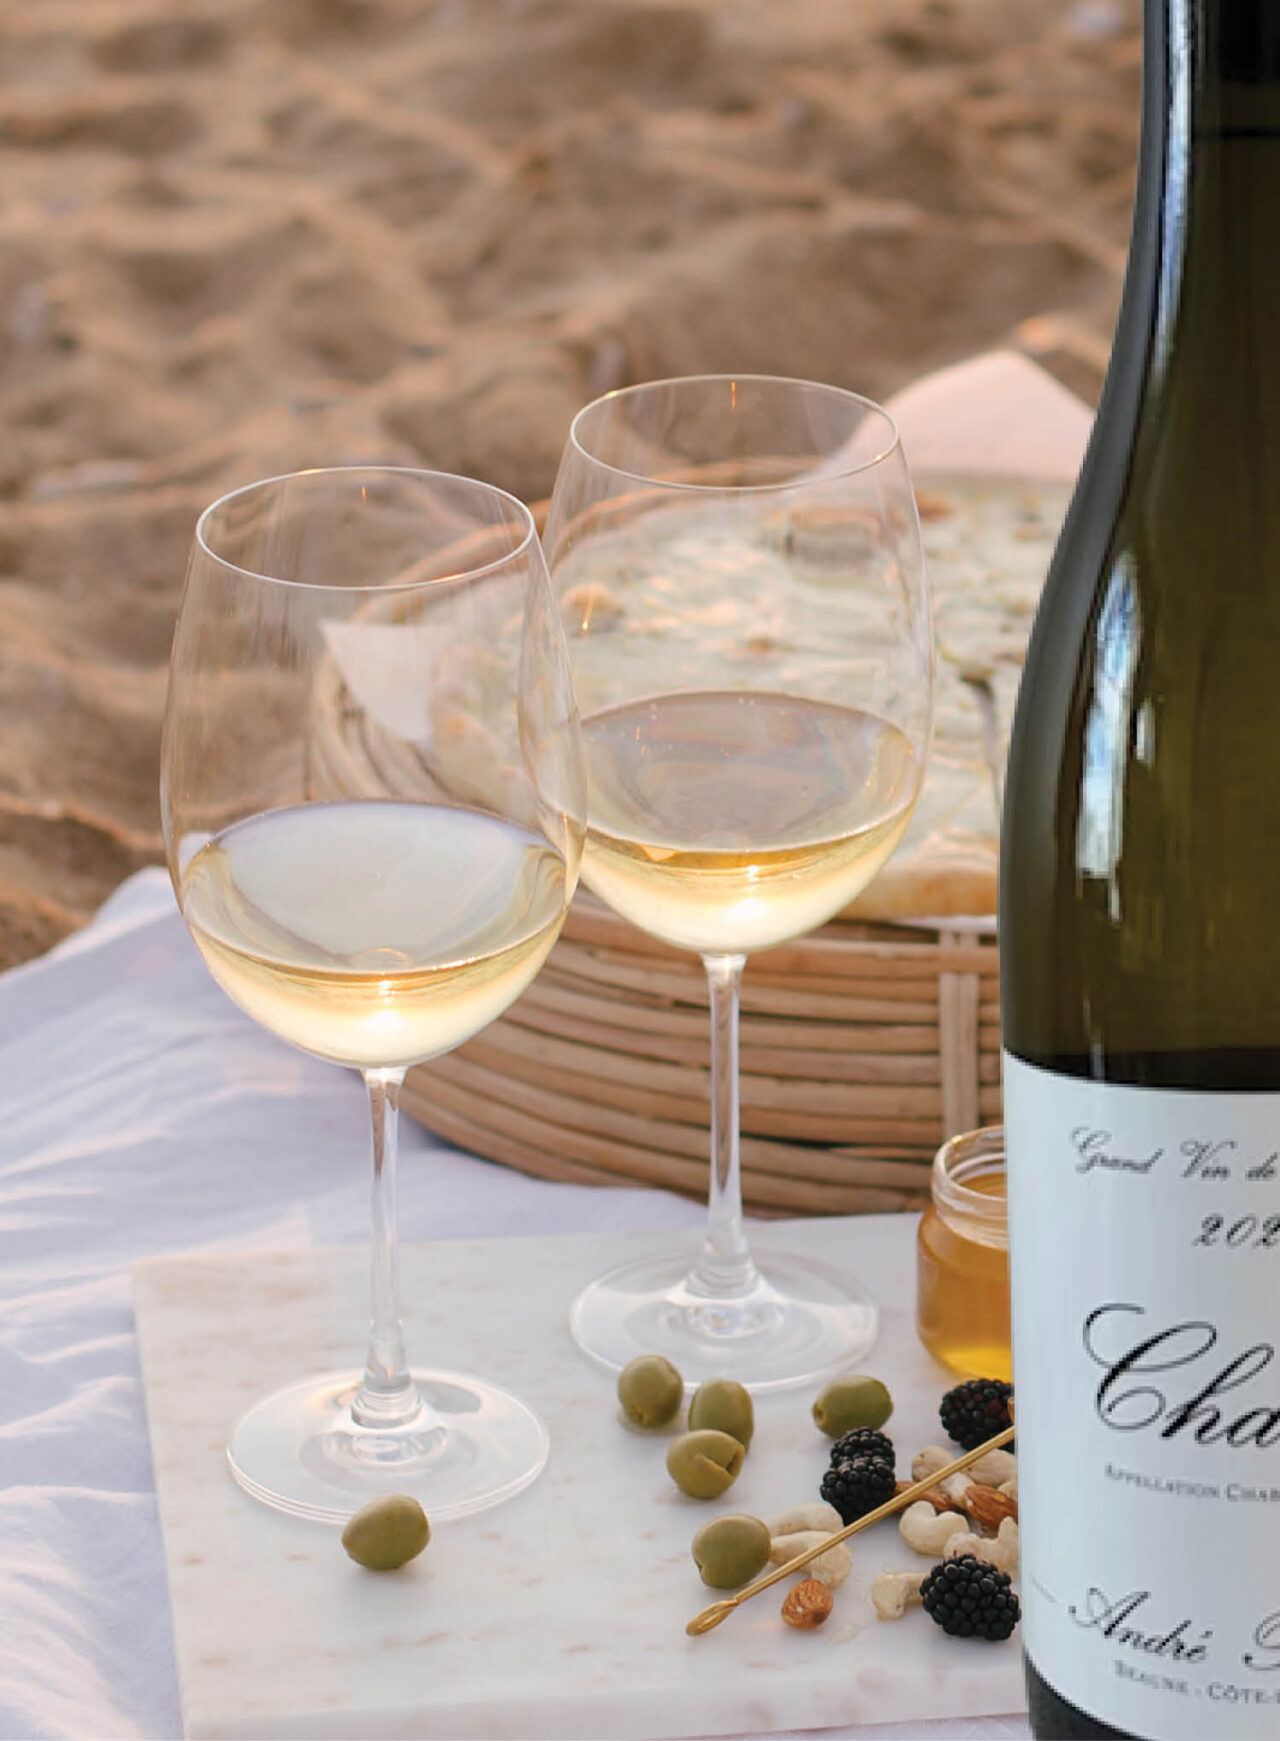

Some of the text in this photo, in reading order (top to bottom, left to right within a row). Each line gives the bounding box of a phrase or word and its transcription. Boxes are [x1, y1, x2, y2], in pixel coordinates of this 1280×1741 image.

[1072, 1126, 1164, 1174] Grand
[1180, 1140, 1238, 1180] Vin
[1245, 1151, 1279, 1181] de
[1068, 1586, 1213, 1664] André
